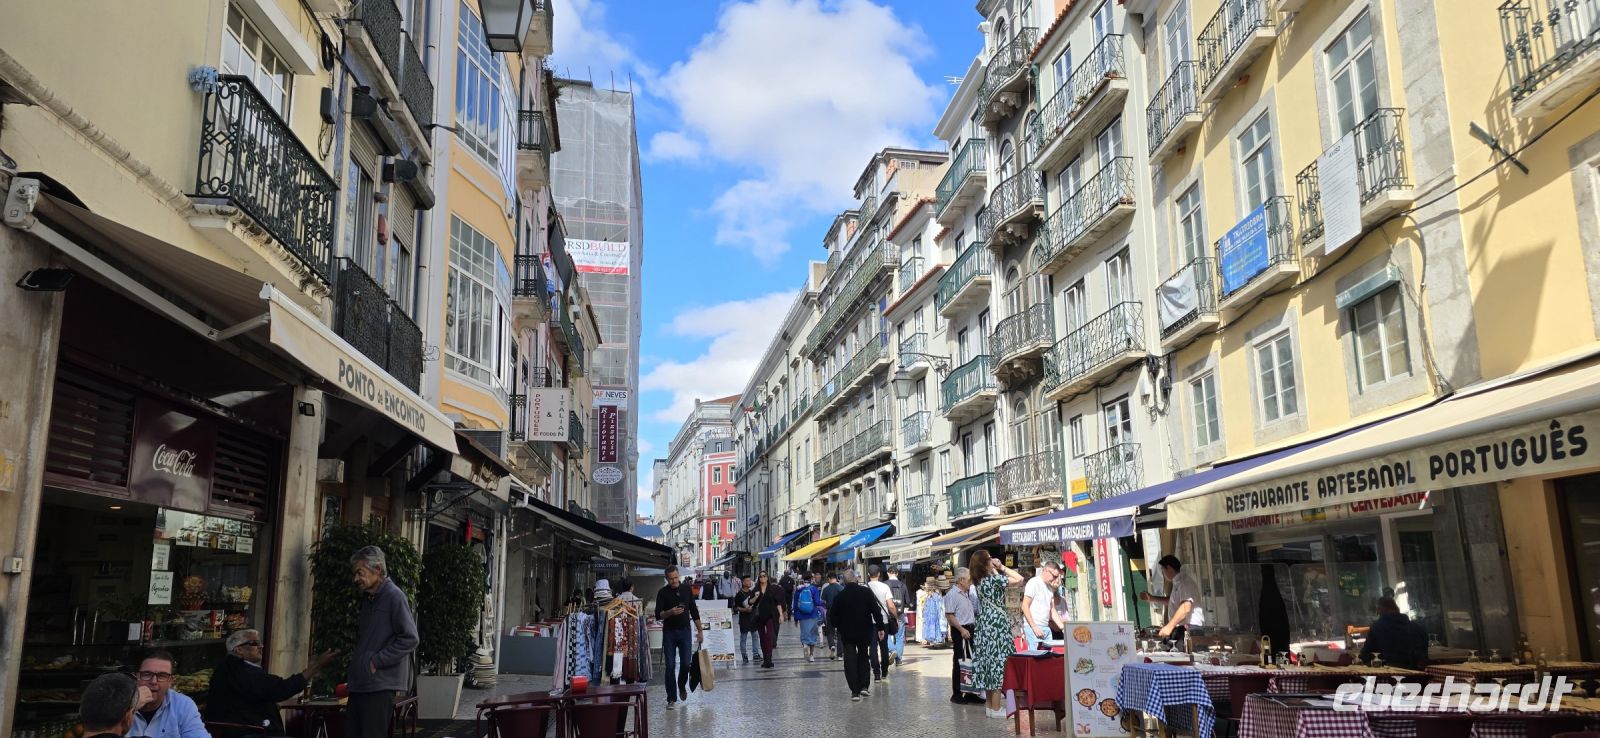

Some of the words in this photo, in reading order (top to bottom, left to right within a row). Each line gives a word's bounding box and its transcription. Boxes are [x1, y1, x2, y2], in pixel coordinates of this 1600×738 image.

[338, 358, 375, 402] PONTO
[377, 390, 383, 405] de
[384, 390, 425, 432] ENCONTRO
[533, 393, 541, 437] PORTUGUESE
[605, 391, 627, 399] NEVES
[600, 407, 608, 461] Ristorante
[152, 443, 197, 478] Coca-Cola
[1226, 480, 1309, 514] RESTAURANTE
[1317, 460, 1417, 498] ARTESANAL
[1429, 419, 1588, 481] PORTUGUÊS
[1011, 530, 1037, 543] RESTAURANTE
[1039, 527, 1060, 541] INHACA
[1061, 524, 1094, 539] MARISQUEIRA
[1098, 521, 1111, 536] 1974
